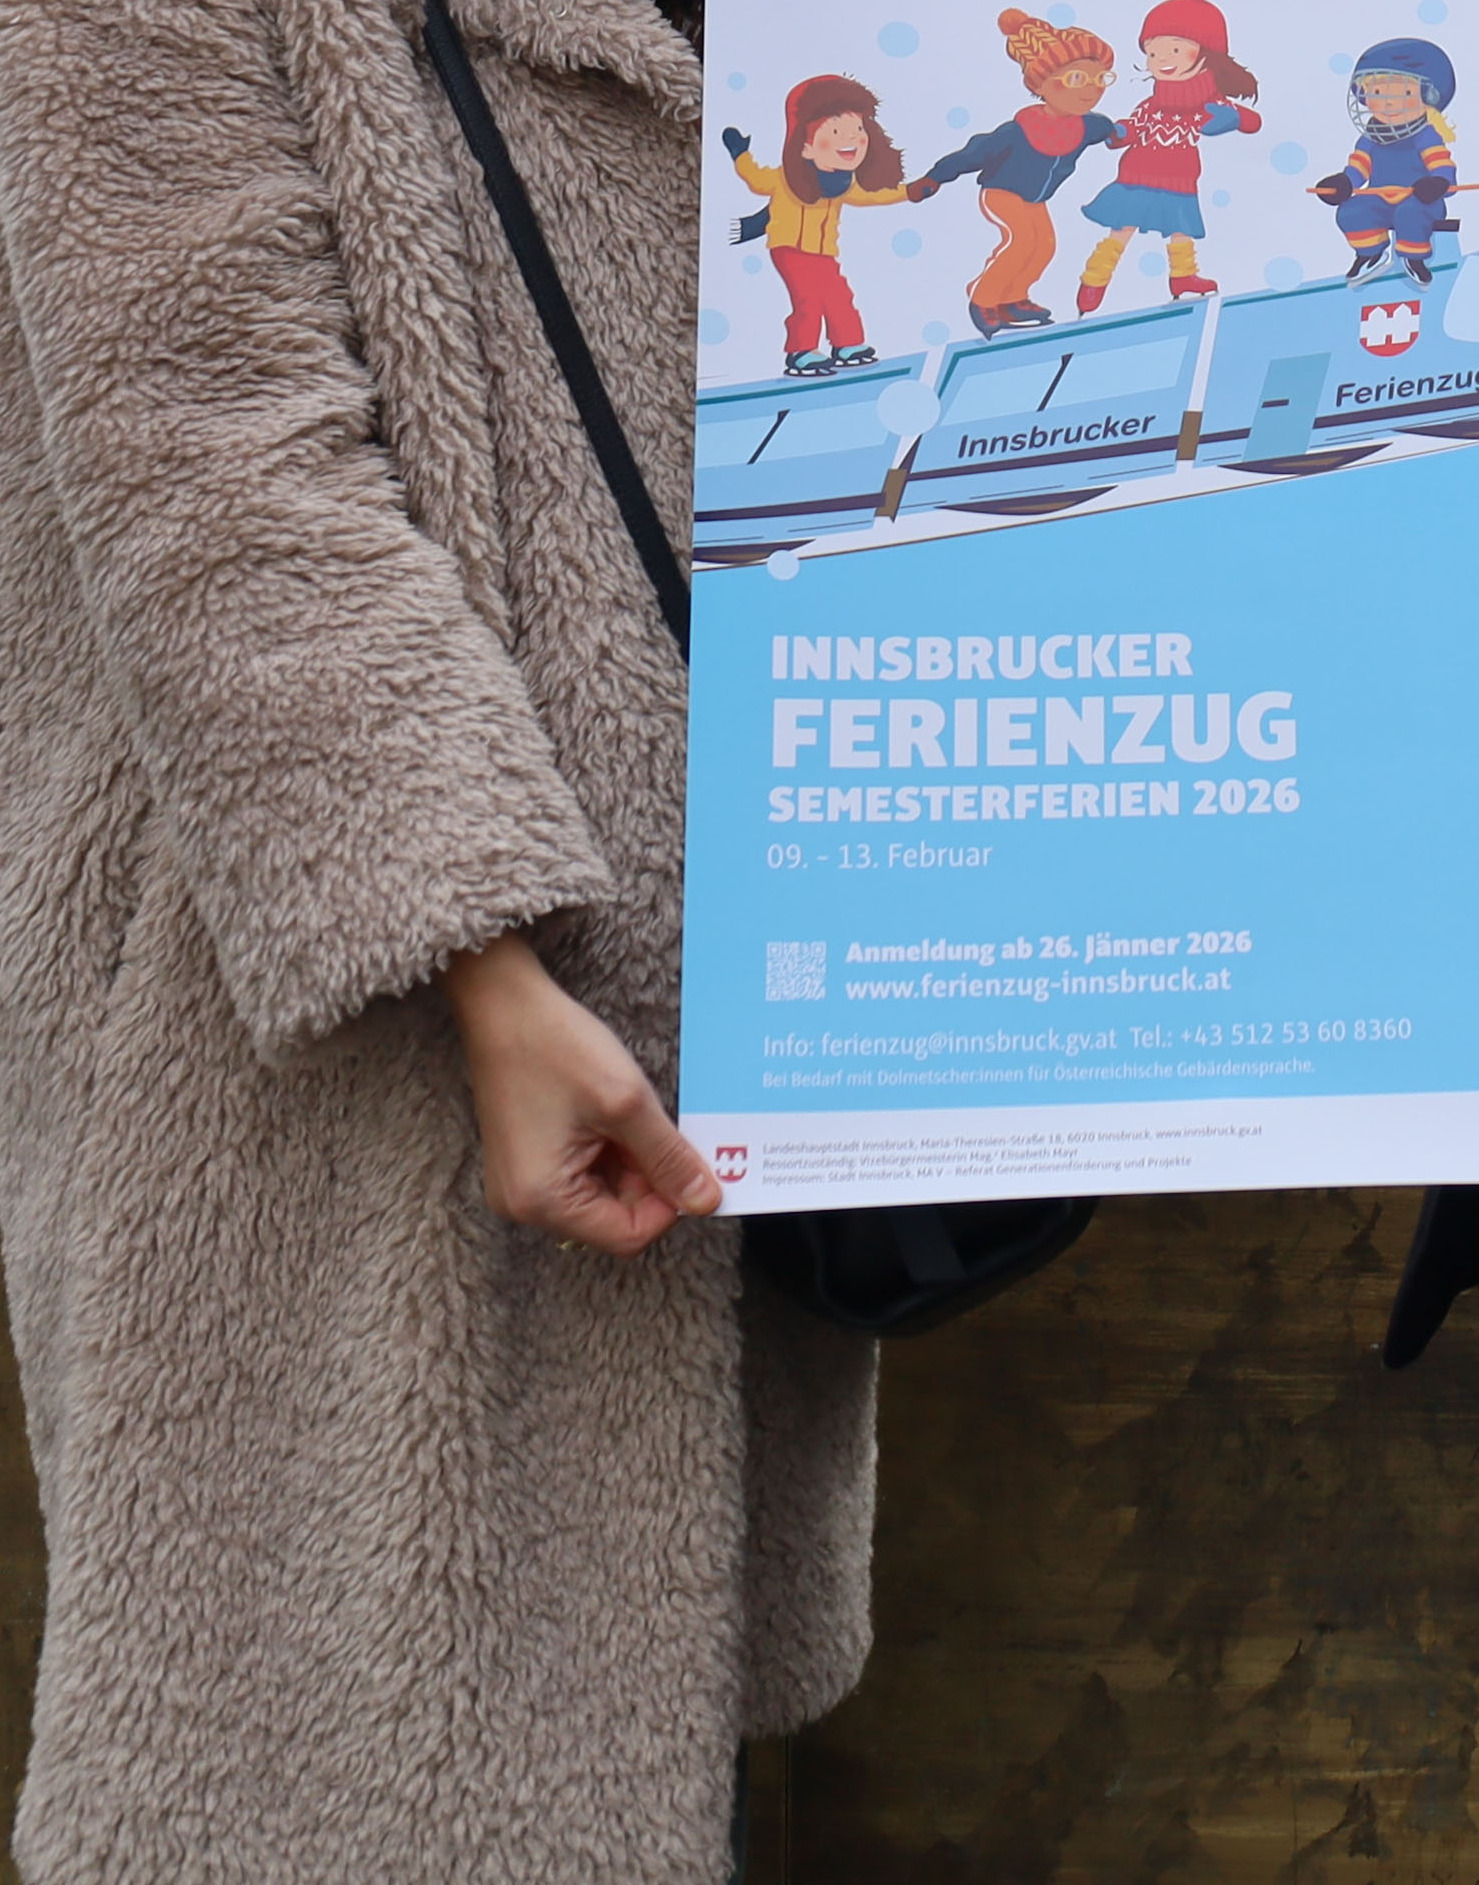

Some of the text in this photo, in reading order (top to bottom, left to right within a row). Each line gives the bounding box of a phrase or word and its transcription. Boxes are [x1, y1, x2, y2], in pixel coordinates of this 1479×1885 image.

[957, 414, 1156, 458] Innsbrucker
[772, 632, 1194, 681] INNSBRUCKER
[772, 690, 1297, 769] FERIENZUG
[768, 778, 1301, 822] SEMESTERFERIEN 2026
[767, 844, 809, 869] 09.
[838, 843, 879, 869] 13.
[888, 841, 993, 868] Februar
[845, 930, 1253, 966] Anmeldung ab 26. Jänner 2026
[845, 965, 1232, 1003] www.ferienzug-innsbruck.at
[763, 1017, 1412, 1061] Info: ferienzug@innsbruck.gv.at Tel.: +43 512 53 60 8360
[762, 1057, 1316, 1088] Bei Bedarf mit Dolmetscher:innen für Österreichische Gebärdensprache.
